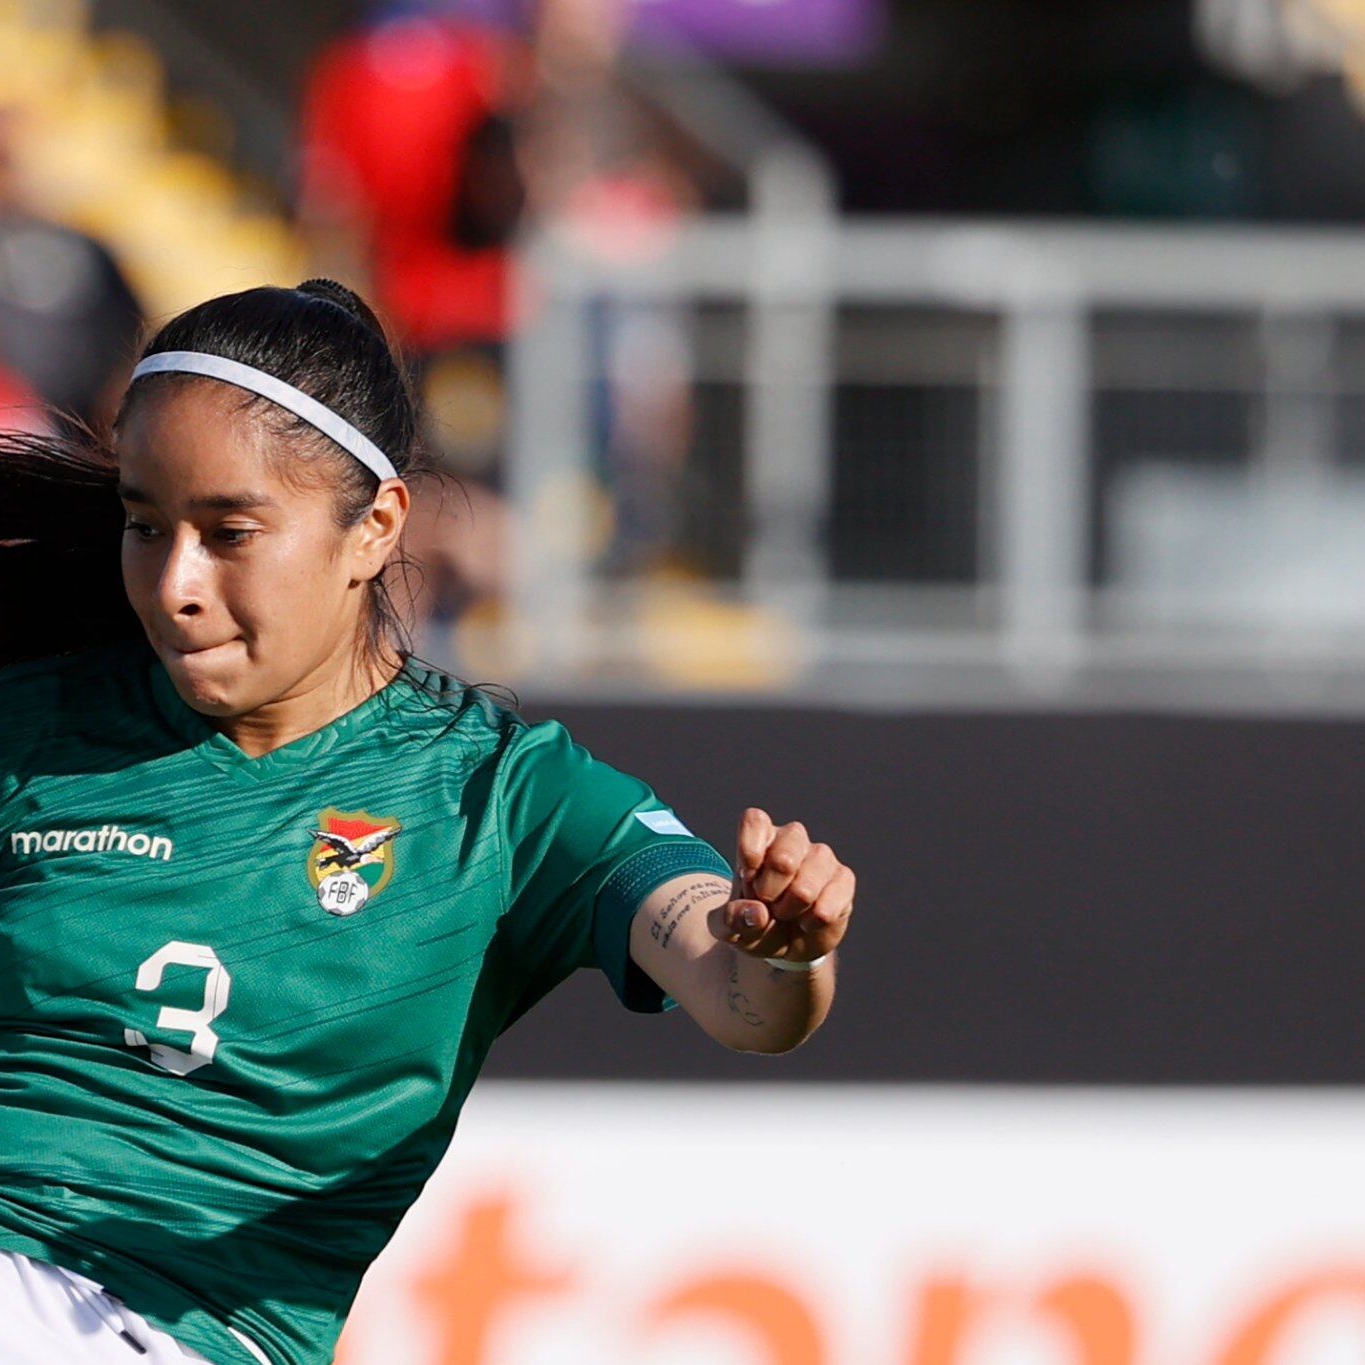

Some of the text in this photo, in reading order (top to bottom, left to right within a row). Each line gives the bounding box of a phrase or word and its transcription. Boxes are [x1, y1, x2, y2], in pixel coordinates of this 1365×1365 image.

[11, 824, 173, 861] marathon
[328, 880, 359, 904] FBF
[124, 939, 232, 1077] 3
